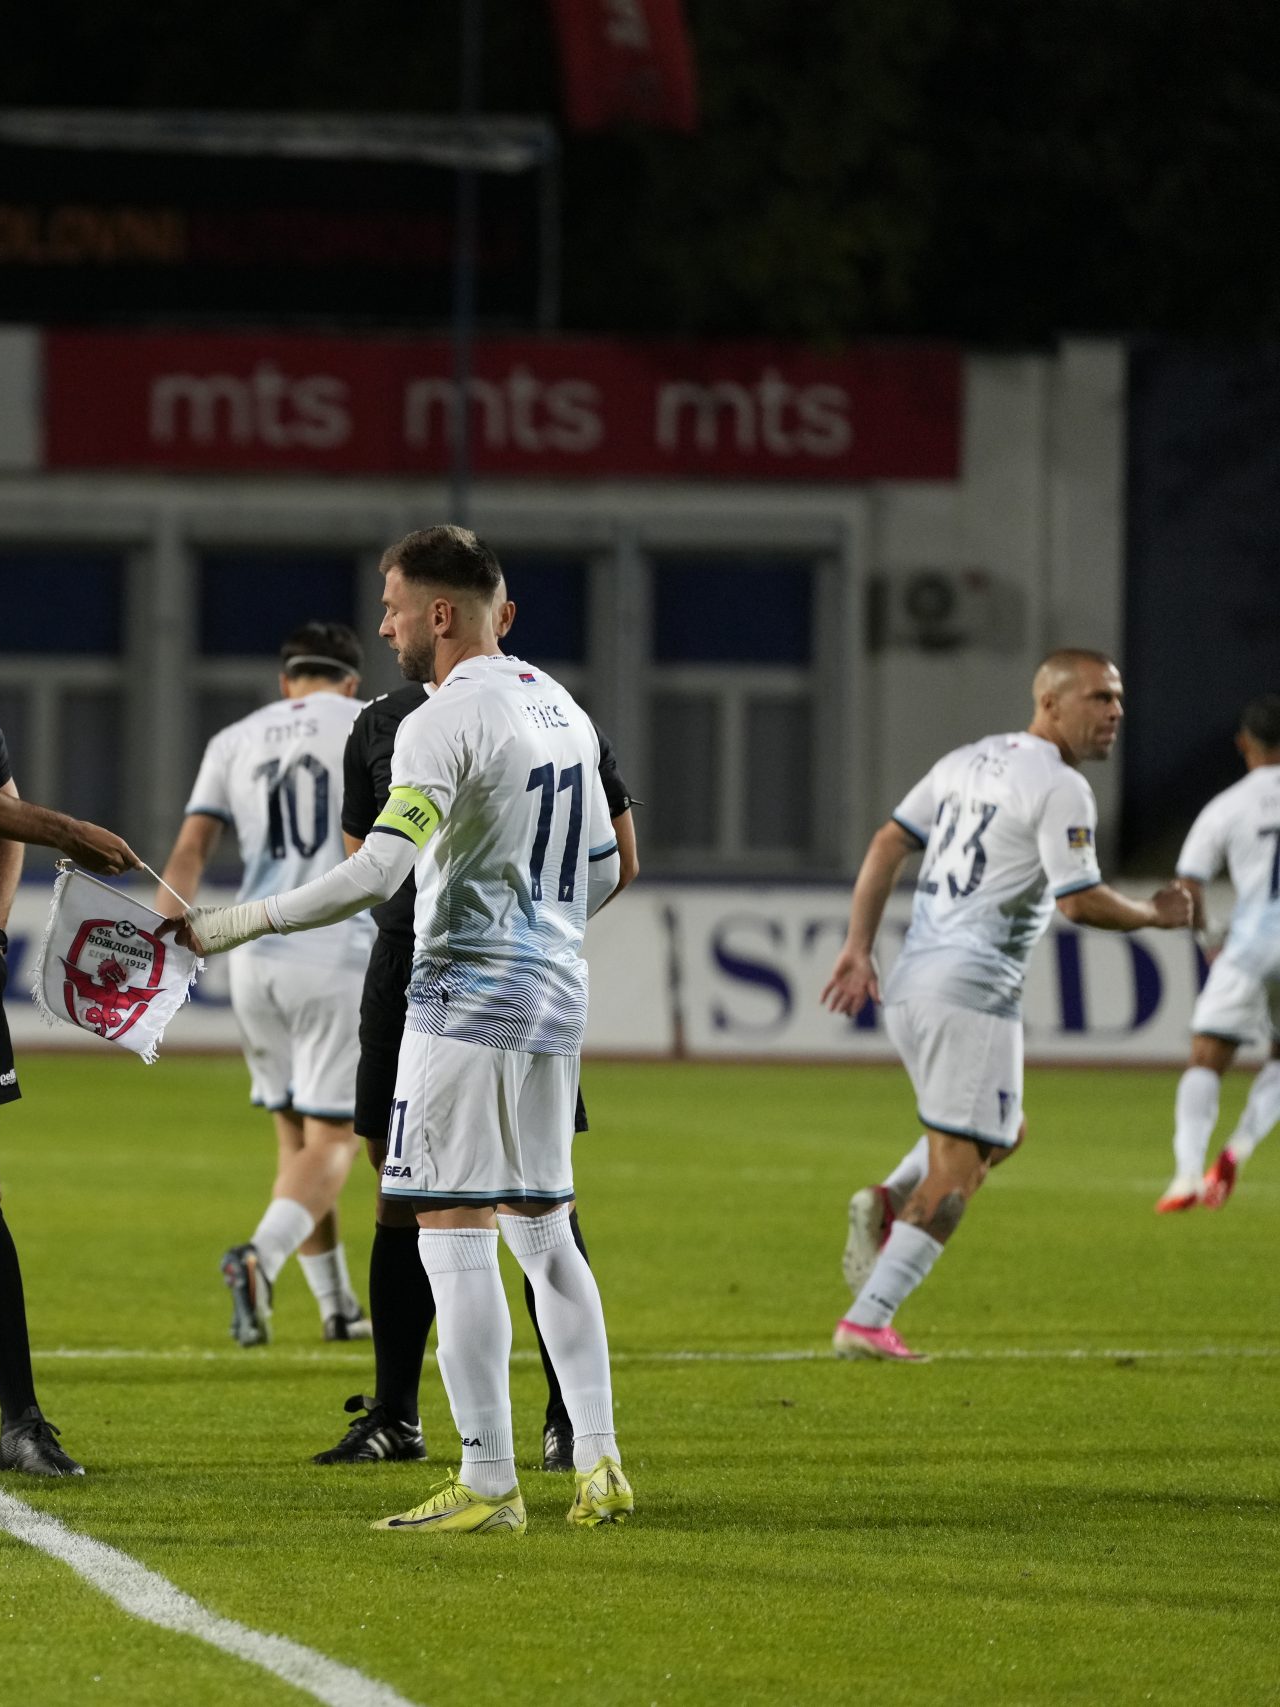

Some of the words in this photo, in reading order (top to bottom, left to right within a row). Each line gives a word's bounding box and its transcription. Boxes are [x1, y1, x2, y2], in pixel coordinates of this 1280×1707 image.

[147, 357, 354, 452] mts
[404, 361, 606, 454] mts
[653, 365, 856, 459] mts
[251, 754, 329, 860] 10
[526, 761, 582, 902] 11
[918, 792, 997, 898] 23
[87, 934, 153, 962] ВОЖДОВАЦ
[96, 927, 113, 938] ФК
[125, 958, 147, 971] 1912
